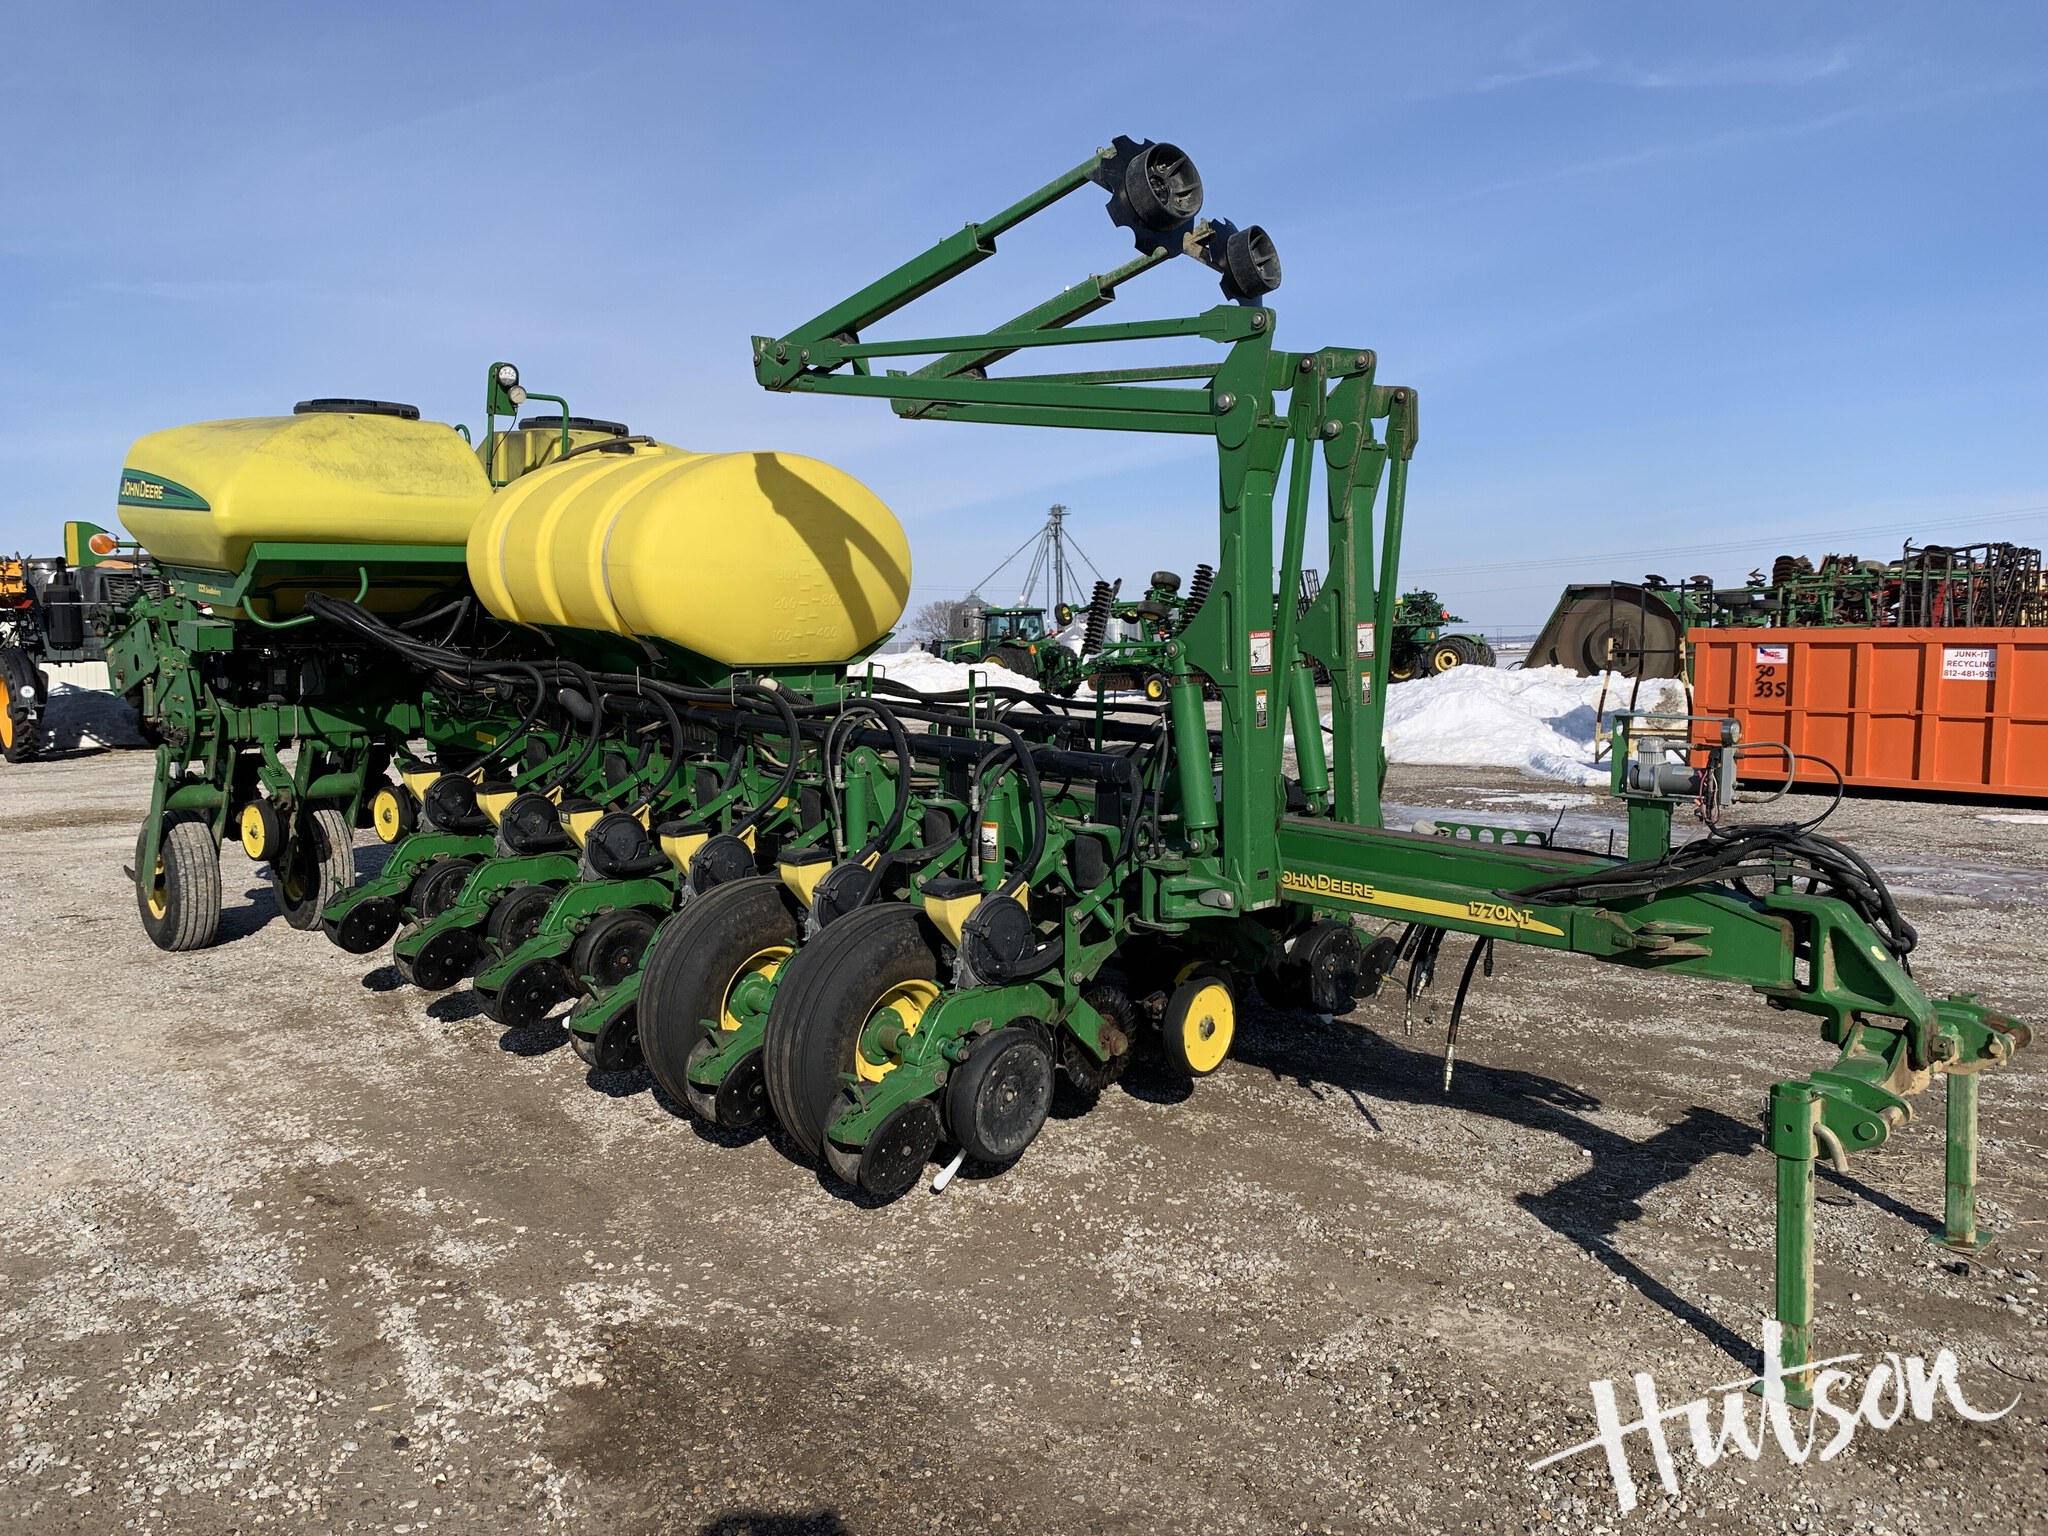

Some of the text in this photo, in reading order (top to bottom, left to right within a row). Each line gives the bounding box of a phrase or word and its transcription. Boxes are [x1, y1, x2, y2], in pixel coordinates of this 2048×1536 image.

[122, 479, 164, 499] JOHN DEERE
[776, 567, 800, 581] 300
[773, 596, 798, 610] 200
[772, 626, 838, 642] 100 400
[1946, 660, 1996, 668] RECYCLING
[1943, 669, 1997, 678] 812-481-9511
[1281, 870, 1317, 890] OHN
[1317, 873, 1374, 899] DEERE
[1468, 900, 1534, 925] 1770NT
